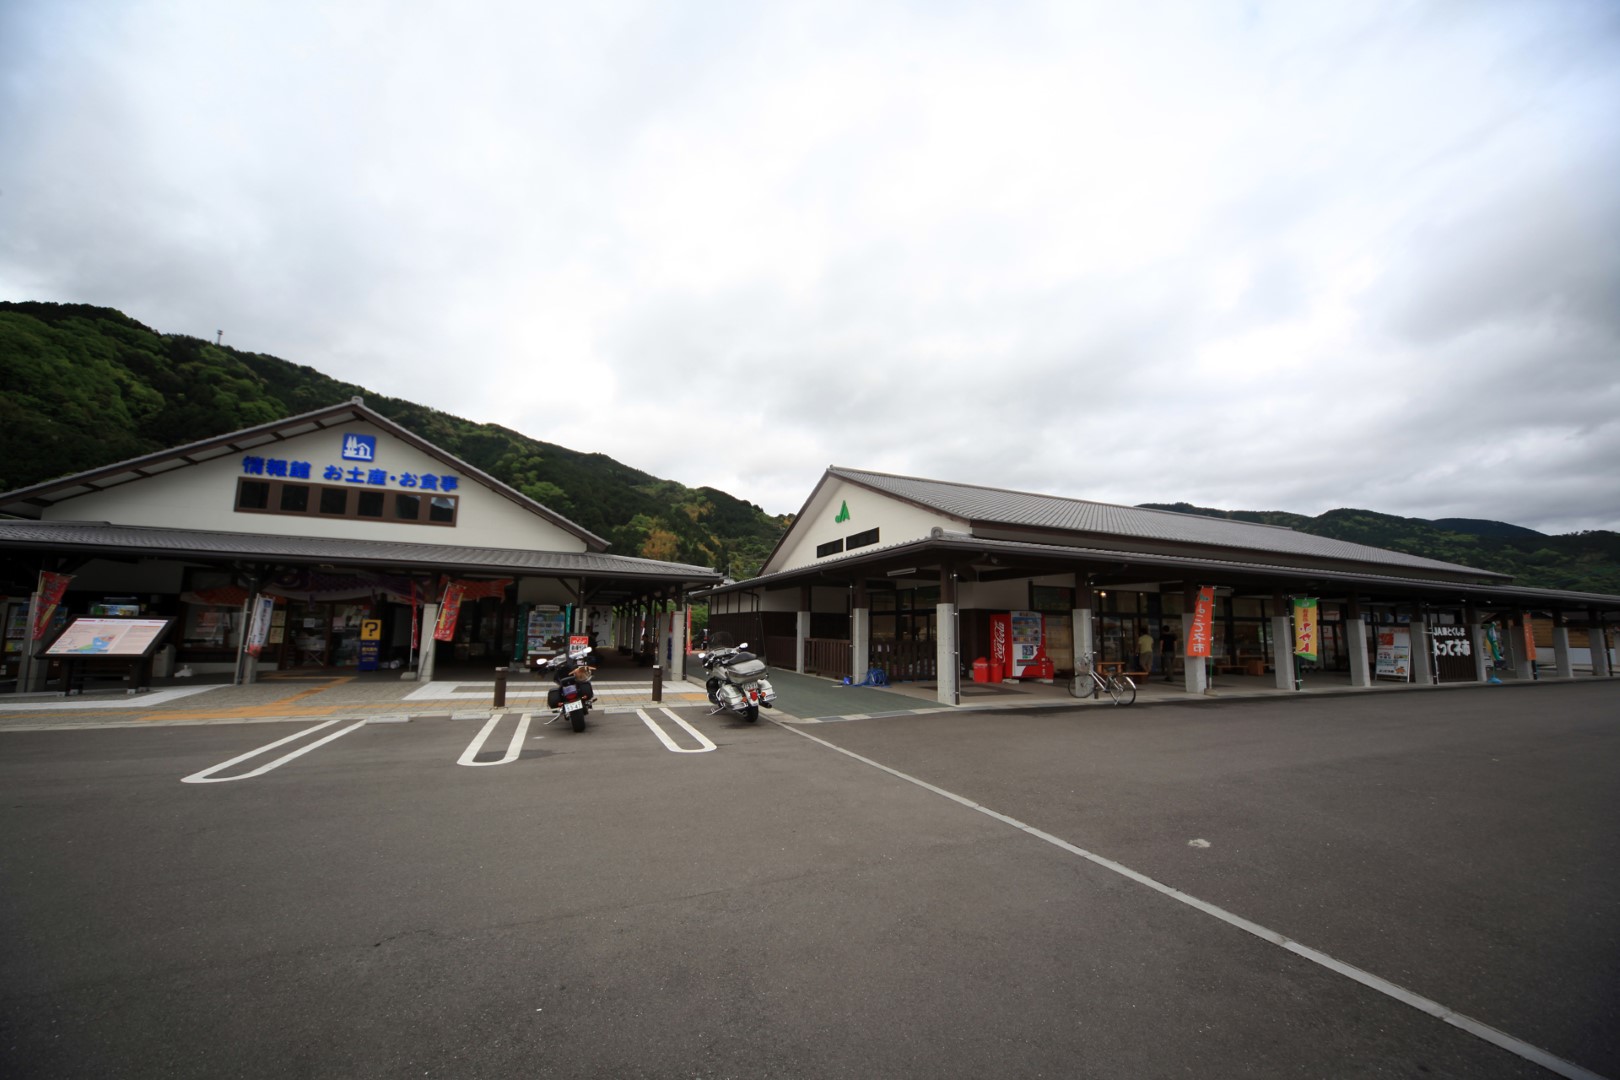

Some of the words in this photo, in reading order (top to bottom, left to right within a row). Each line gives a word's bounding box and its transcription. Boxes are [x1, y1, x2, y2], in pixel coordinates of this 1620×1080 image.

[242, 455, 312, 479] 情報館
[323, 464, 459, 492] お土産・お食事
